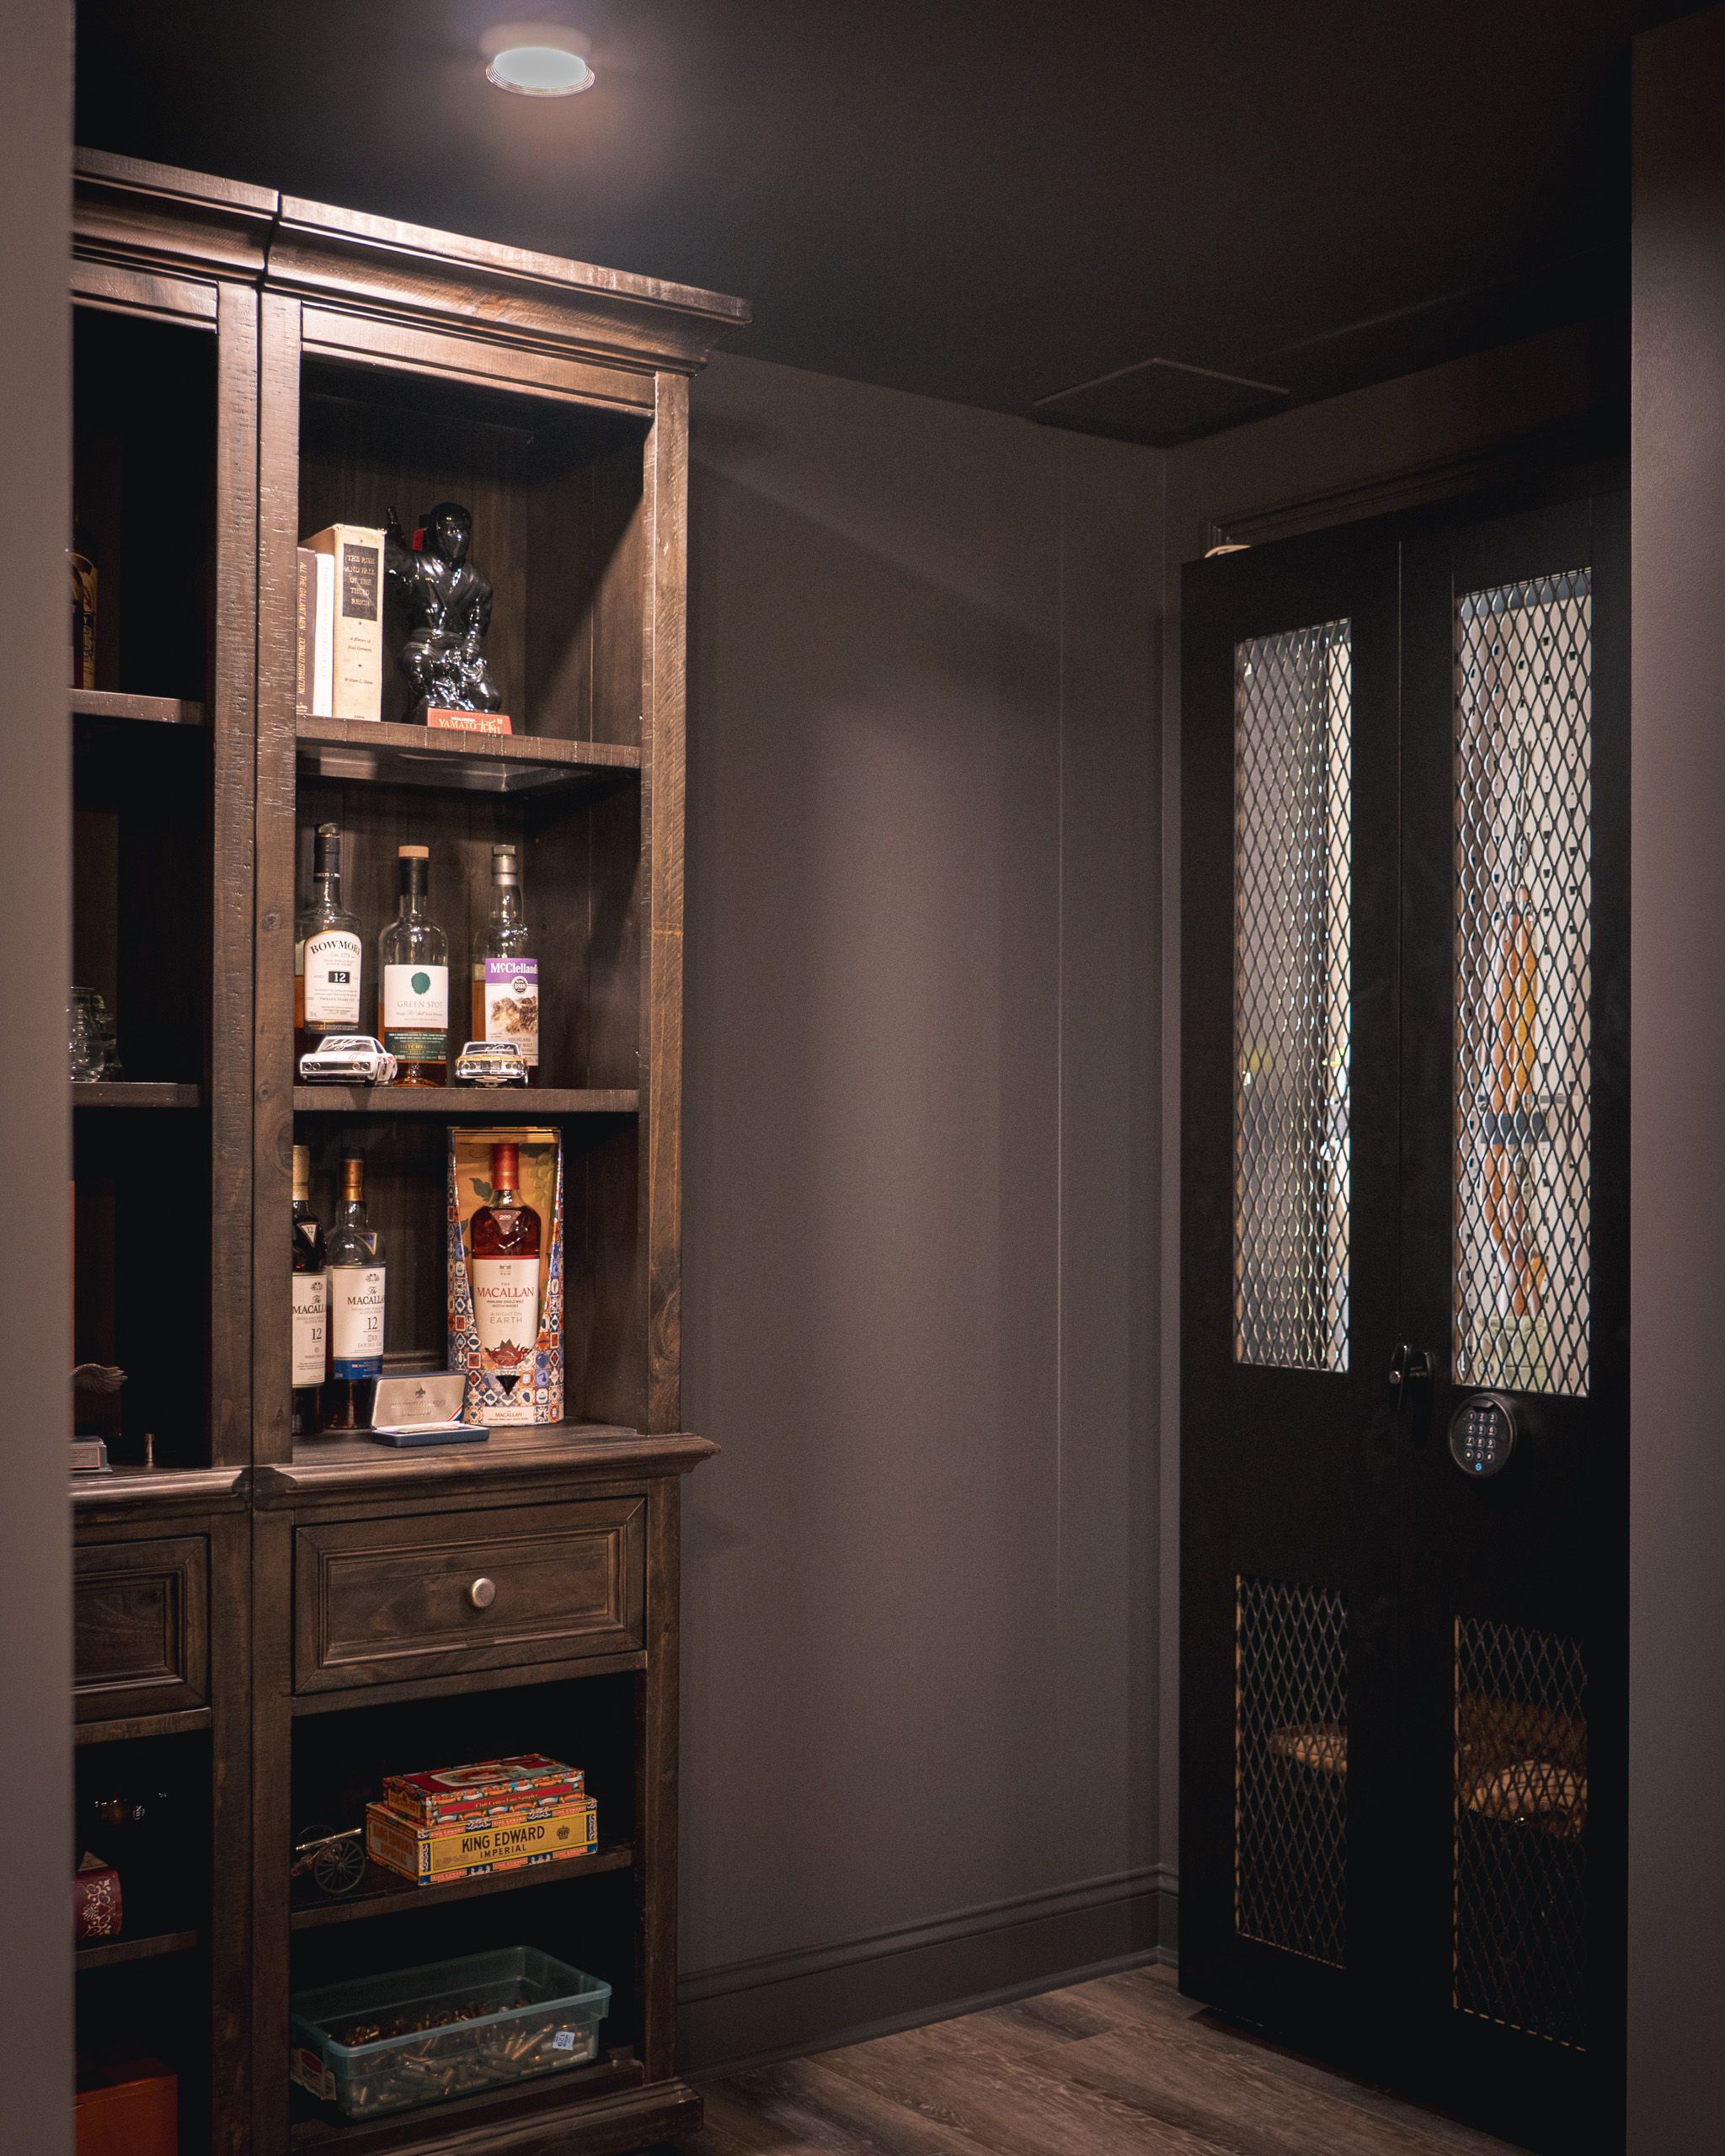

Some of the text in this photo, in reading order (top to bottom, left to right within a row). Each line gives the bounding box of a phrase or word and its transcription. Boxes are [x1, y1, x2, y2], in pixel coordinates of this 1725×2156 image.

[299, 561, 307, 574] ALL
[439, 719, 477, 730] YAMATO
[334, 973, 346, 983] 12
[477, 1287, 535, 1298] MACALLAN
[366, 1316, 378, 1330] 12
[311, 1327, 322, 1341] 12
[462, 1825, 545, 1854] KING EDWARD
[480, 1844, 526, 1859] IMPERIAL
